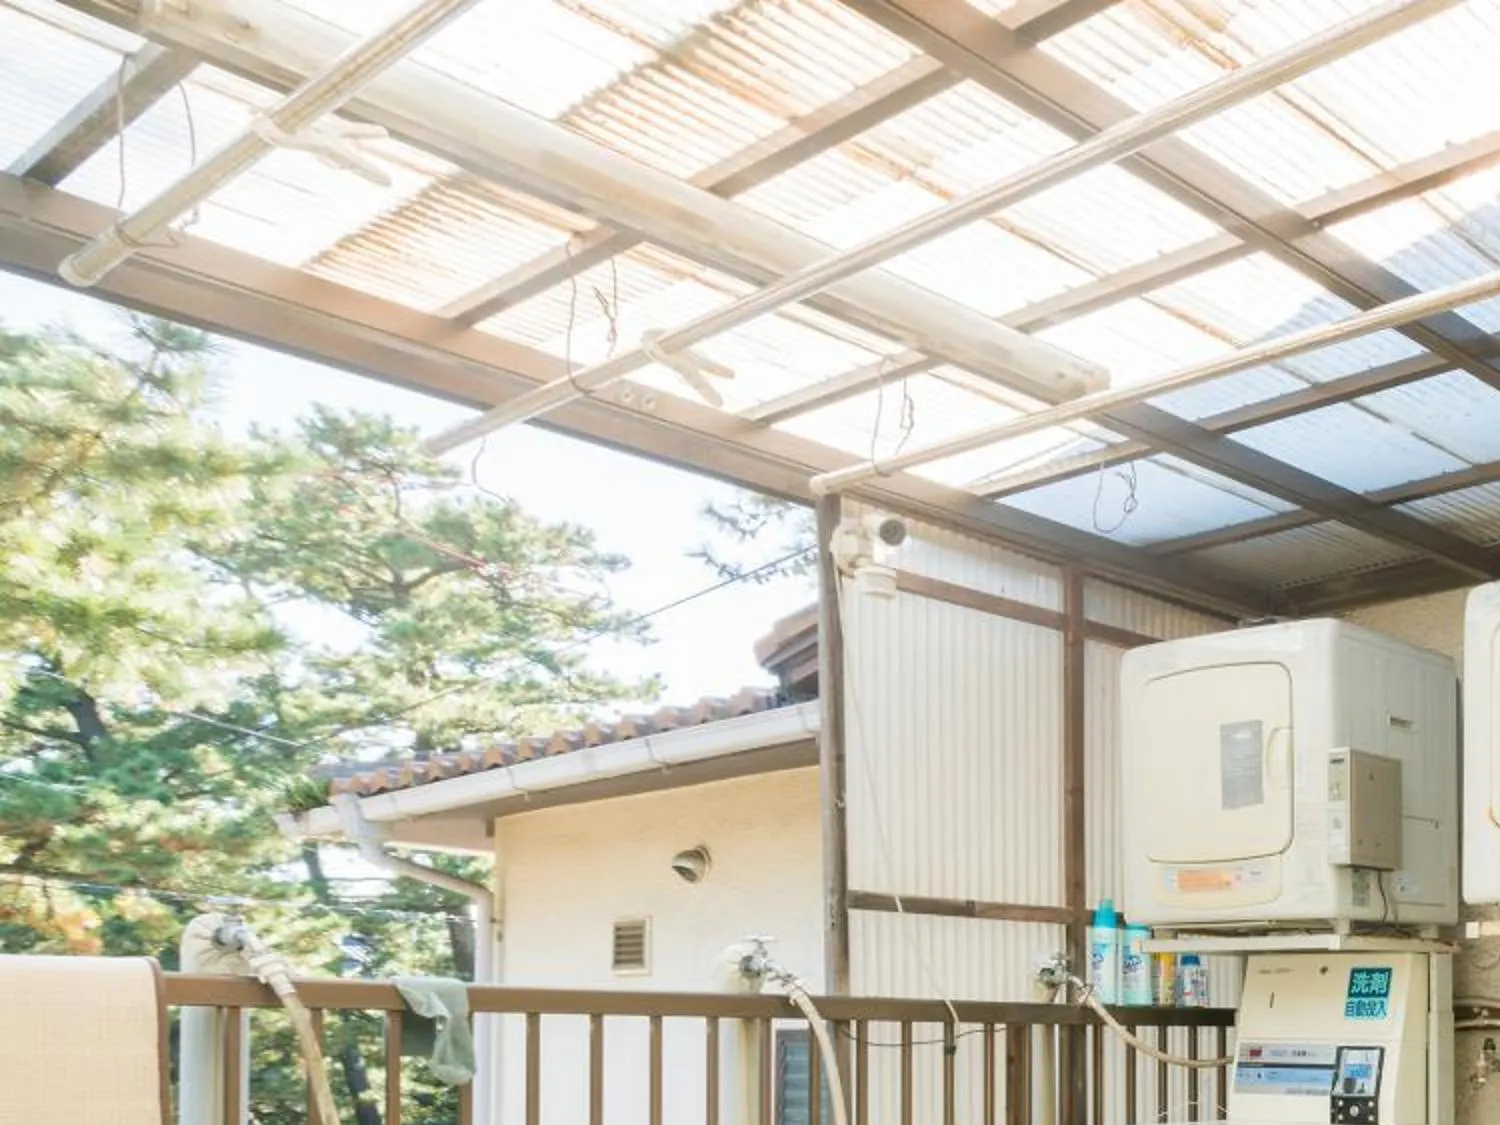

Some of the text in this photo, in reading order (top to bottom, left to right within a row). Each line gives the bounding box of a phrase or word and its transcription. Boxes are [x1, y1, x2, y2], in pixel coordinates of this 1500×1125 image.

[1351, 971, 1389, 994] 洗剤
[1345, 1000, 1387, 1016] 自動投入
